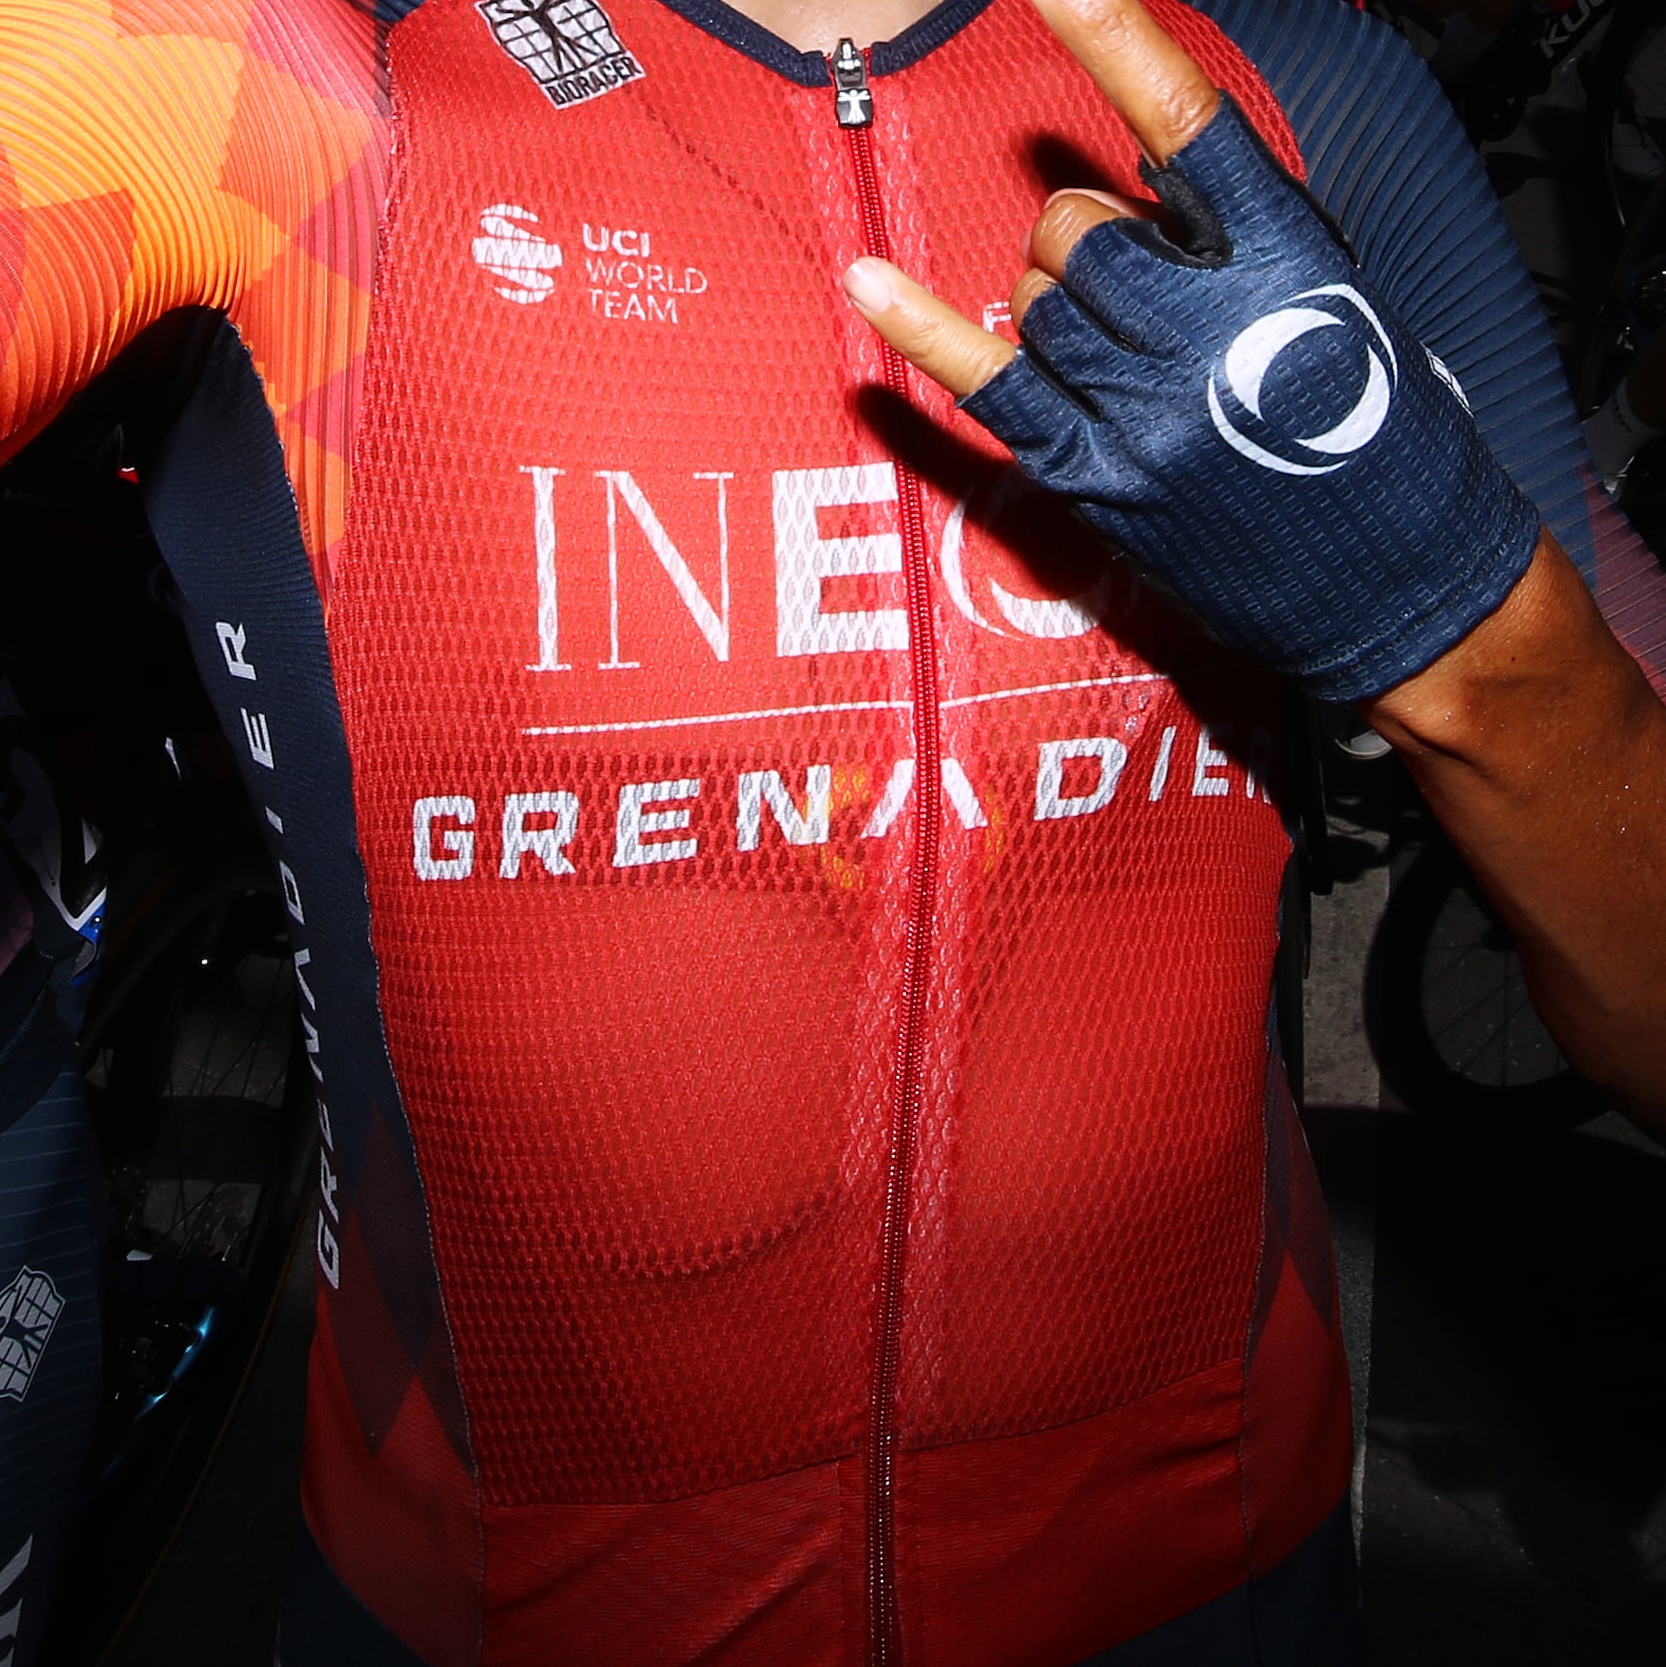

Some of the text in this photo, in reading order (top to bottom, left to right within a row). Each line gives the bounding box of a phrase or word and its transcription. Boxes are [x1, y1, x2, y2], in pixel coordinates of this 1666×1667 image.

[547, 55, 644, 107] BIORACER
[583, 222, 651, 258] UCI
[585, 256, 709, 295] WORLD
[588, 287, 678, 324] TEAM
